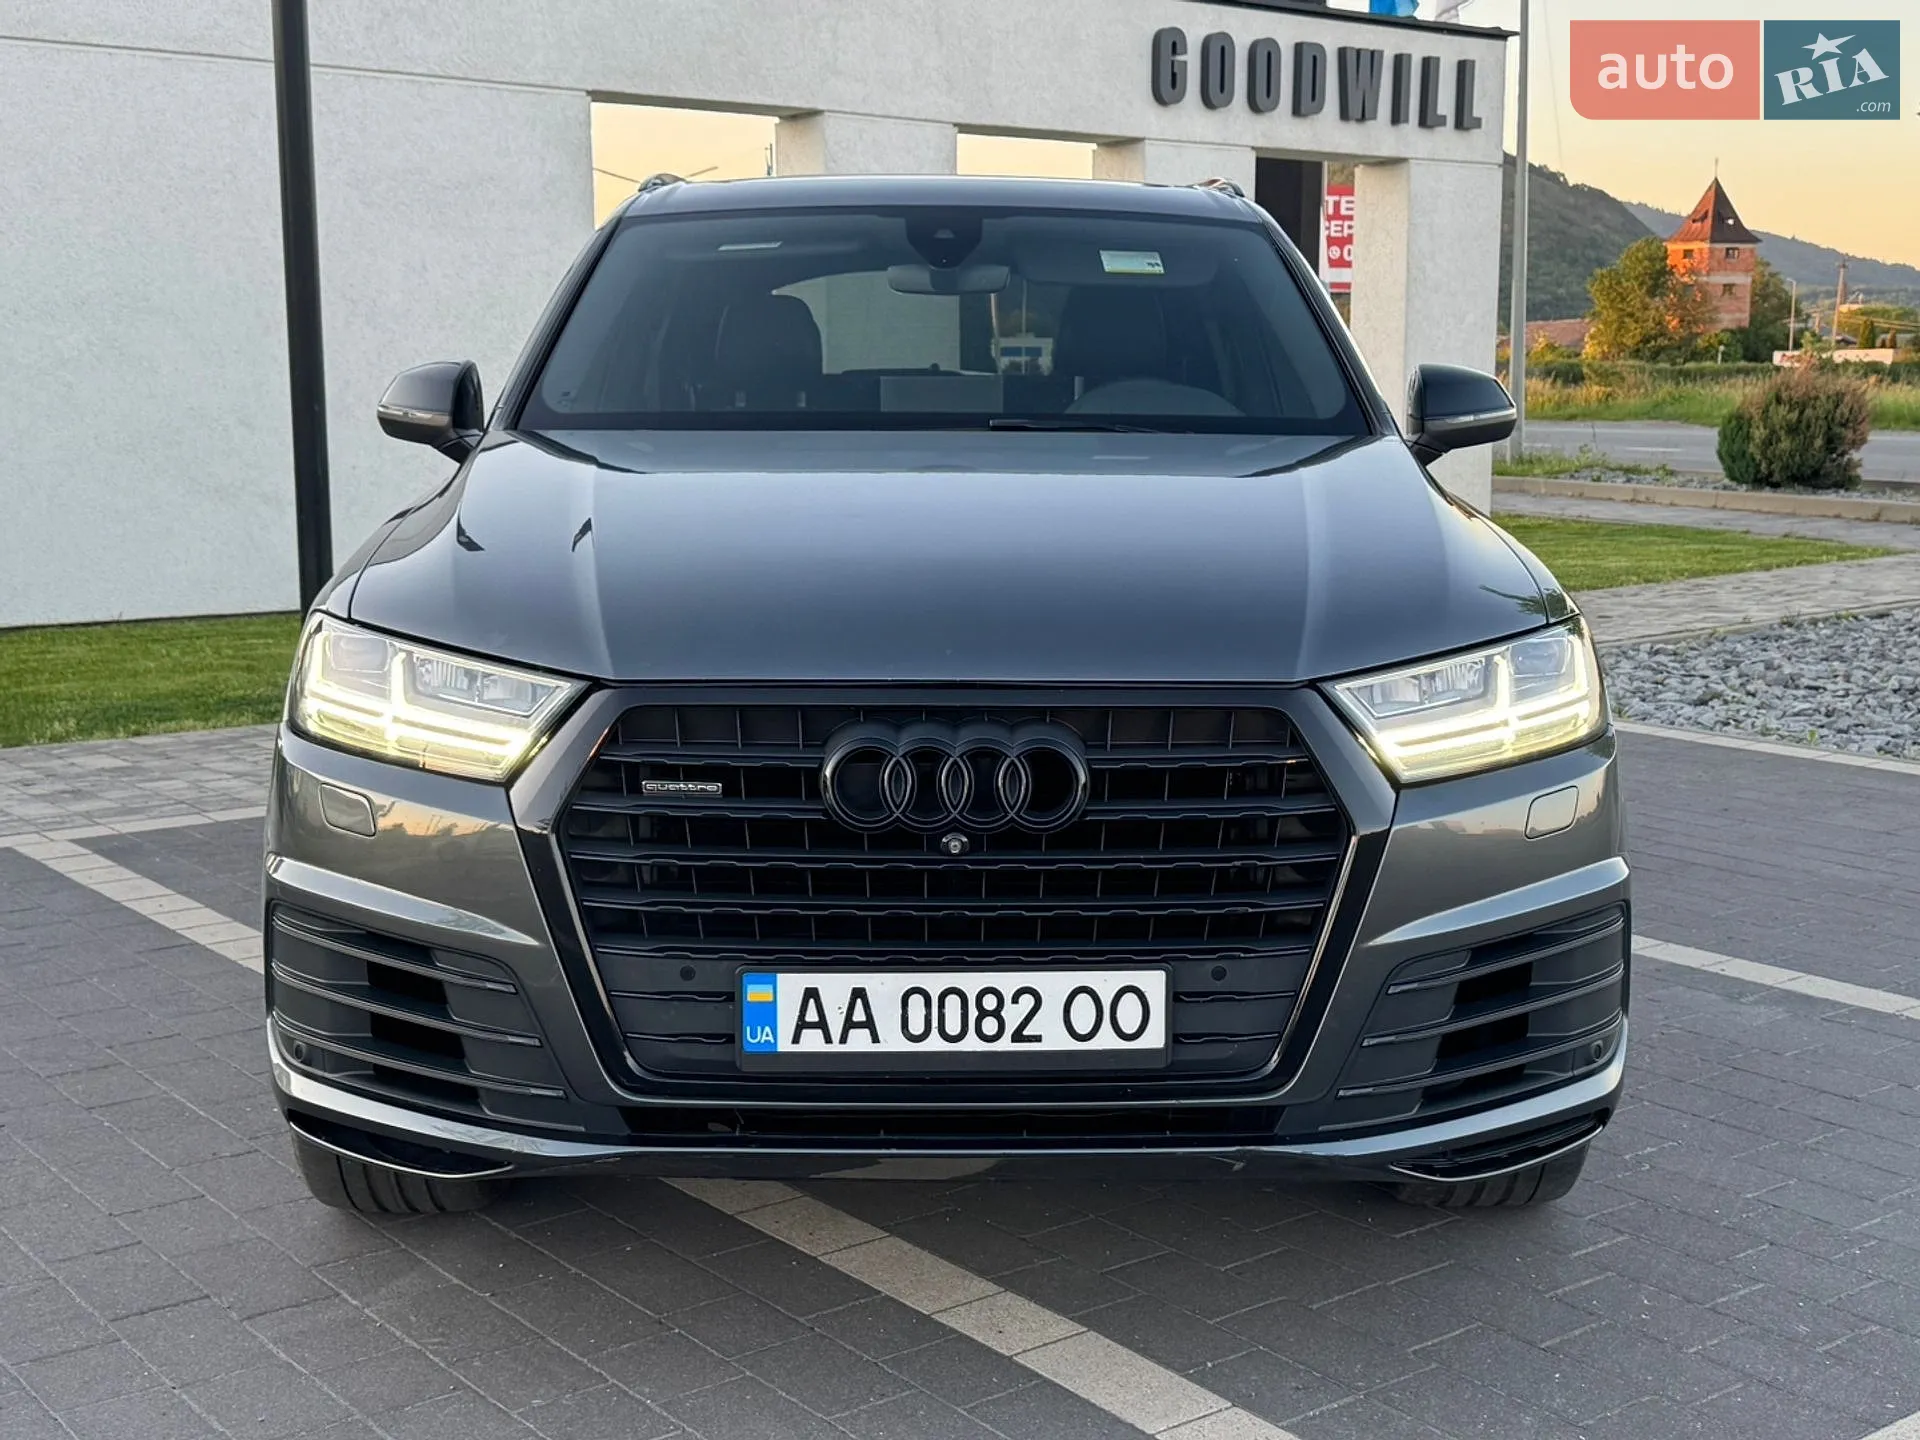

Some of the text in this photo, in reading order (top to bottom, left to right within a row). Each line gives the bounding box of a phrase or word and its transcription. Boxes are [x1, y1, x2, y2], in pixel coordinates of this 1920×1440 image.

[1151, 26, 1483, 130] GOODWILL
[645, 782, 719, 793] quattro
[746, 1025, 775, 1044] UA
[790, 984, 1151, 1045] AA 0082 OO
